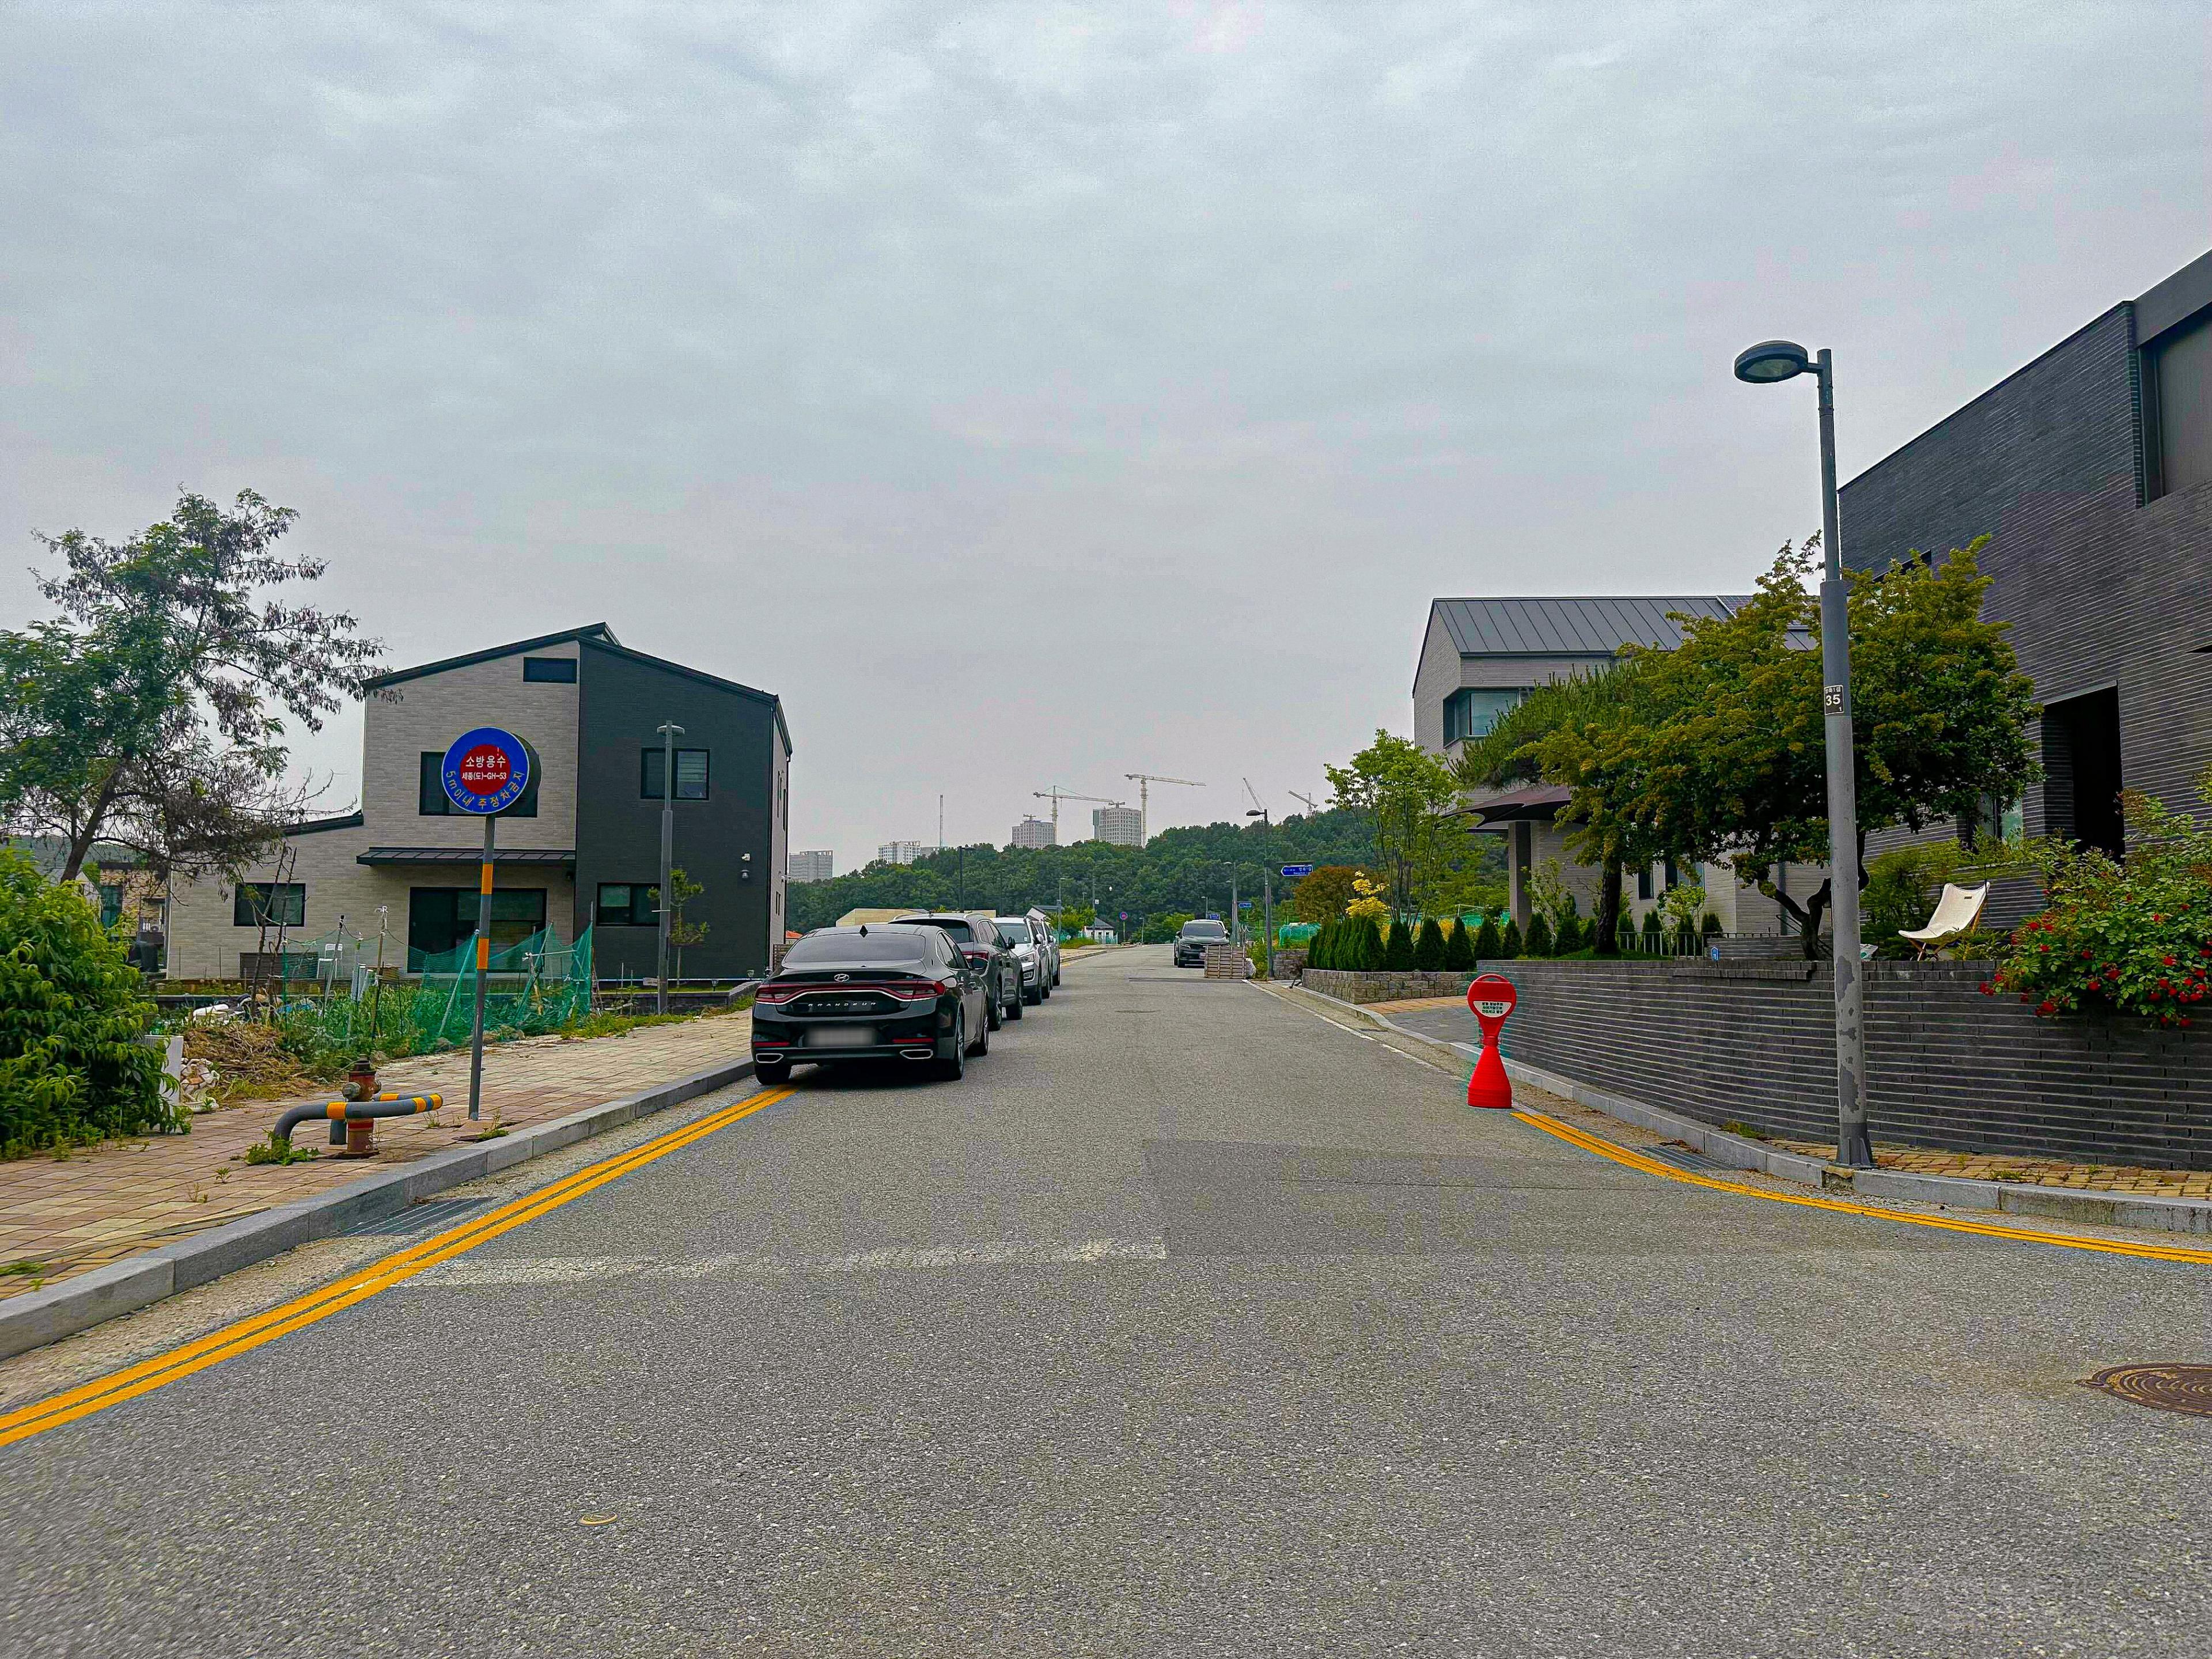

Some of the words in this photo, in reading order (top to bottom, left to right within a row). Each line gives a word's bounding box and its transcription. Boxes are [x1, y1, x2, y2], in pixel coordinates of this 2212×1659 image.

[1826, 694, 1840, 706] 35
[465, 755, 506, 768] 소방용수
[445, 770, 475, 807] 5m이내
